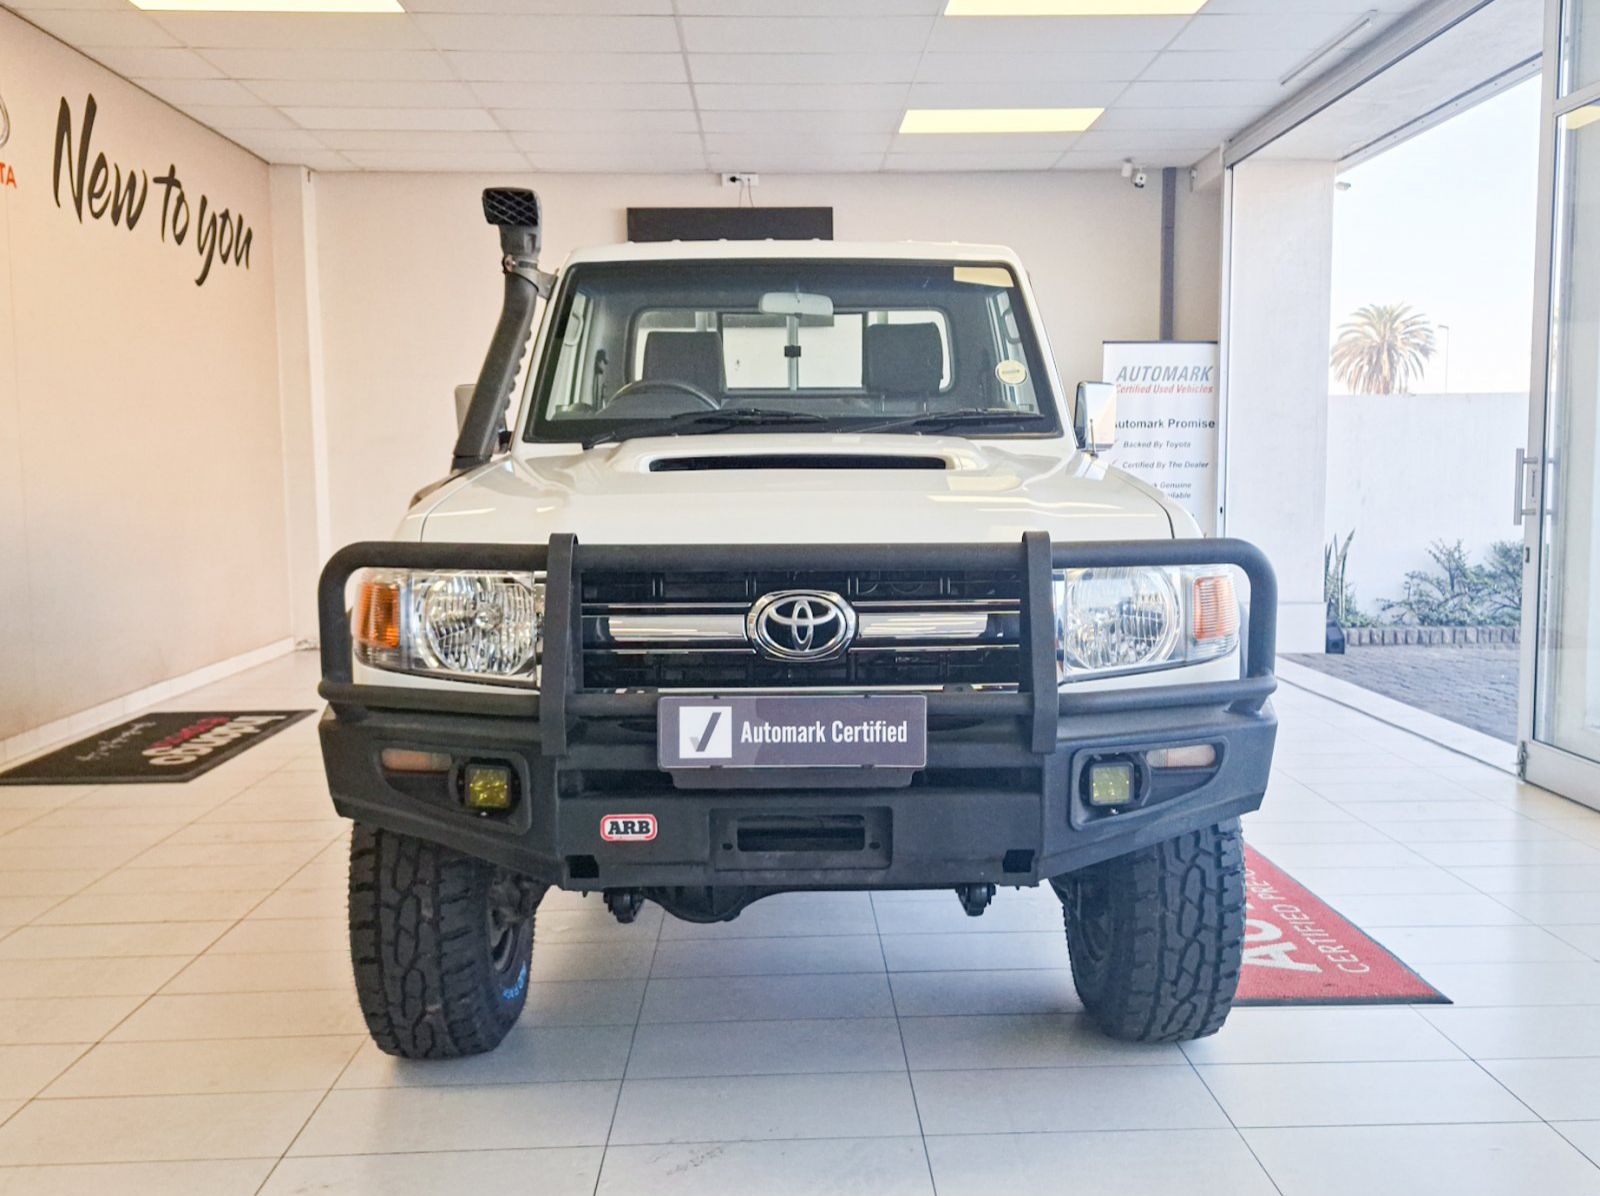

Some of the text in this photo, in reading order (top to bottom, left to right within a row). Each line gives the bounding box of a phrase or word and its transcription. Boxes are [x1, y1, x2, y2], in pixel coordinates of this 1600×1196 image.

[53, 93, 253, 287] New to you
[1117, 366, 1213, 381] AUTOMARK
[1153, 384, 1175, 394] Used
[1176, 384, 1214, 394] Vehicles
[1115, 418, 1216, 429] utomark Promise
[1123, 440, 1192, 450] Backed By Toyota
[1122, 460, 1209, 470] Certified By The Dealer
[1159, 481, 1192, 489] Genuine
[740, 720, 908, 743] Automark Certified
[608, 820, 652, 835] ARB
[1272, 903, 1371, 974] CERTIFIED
